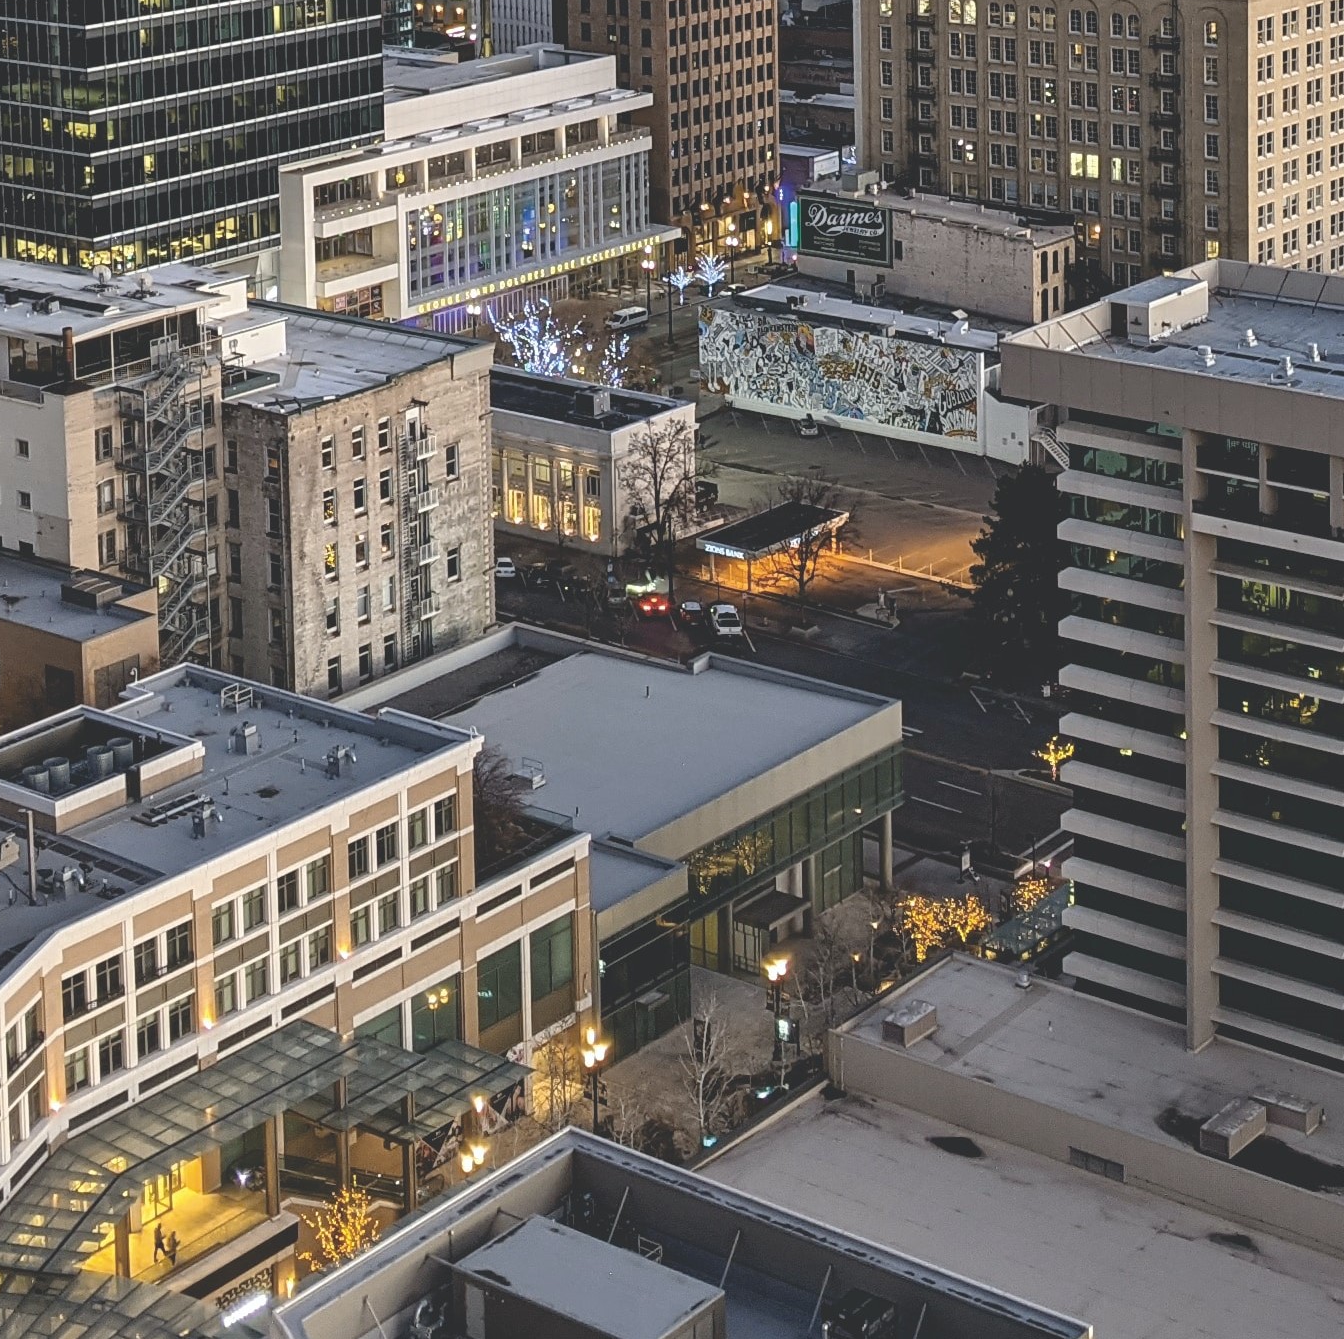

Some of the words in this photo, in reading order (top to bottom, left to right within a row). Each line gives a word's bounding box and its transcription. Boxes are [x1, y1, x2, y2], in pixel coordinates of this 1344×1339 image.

[805, 203, 884, 230] Daynes
[418, 293, 460, 314] GEORGE
[499, 268, 546, 290] DOLORES
[580, 247, 616, 266] ECCLES
[619, 235, 660, 254] THEATER
